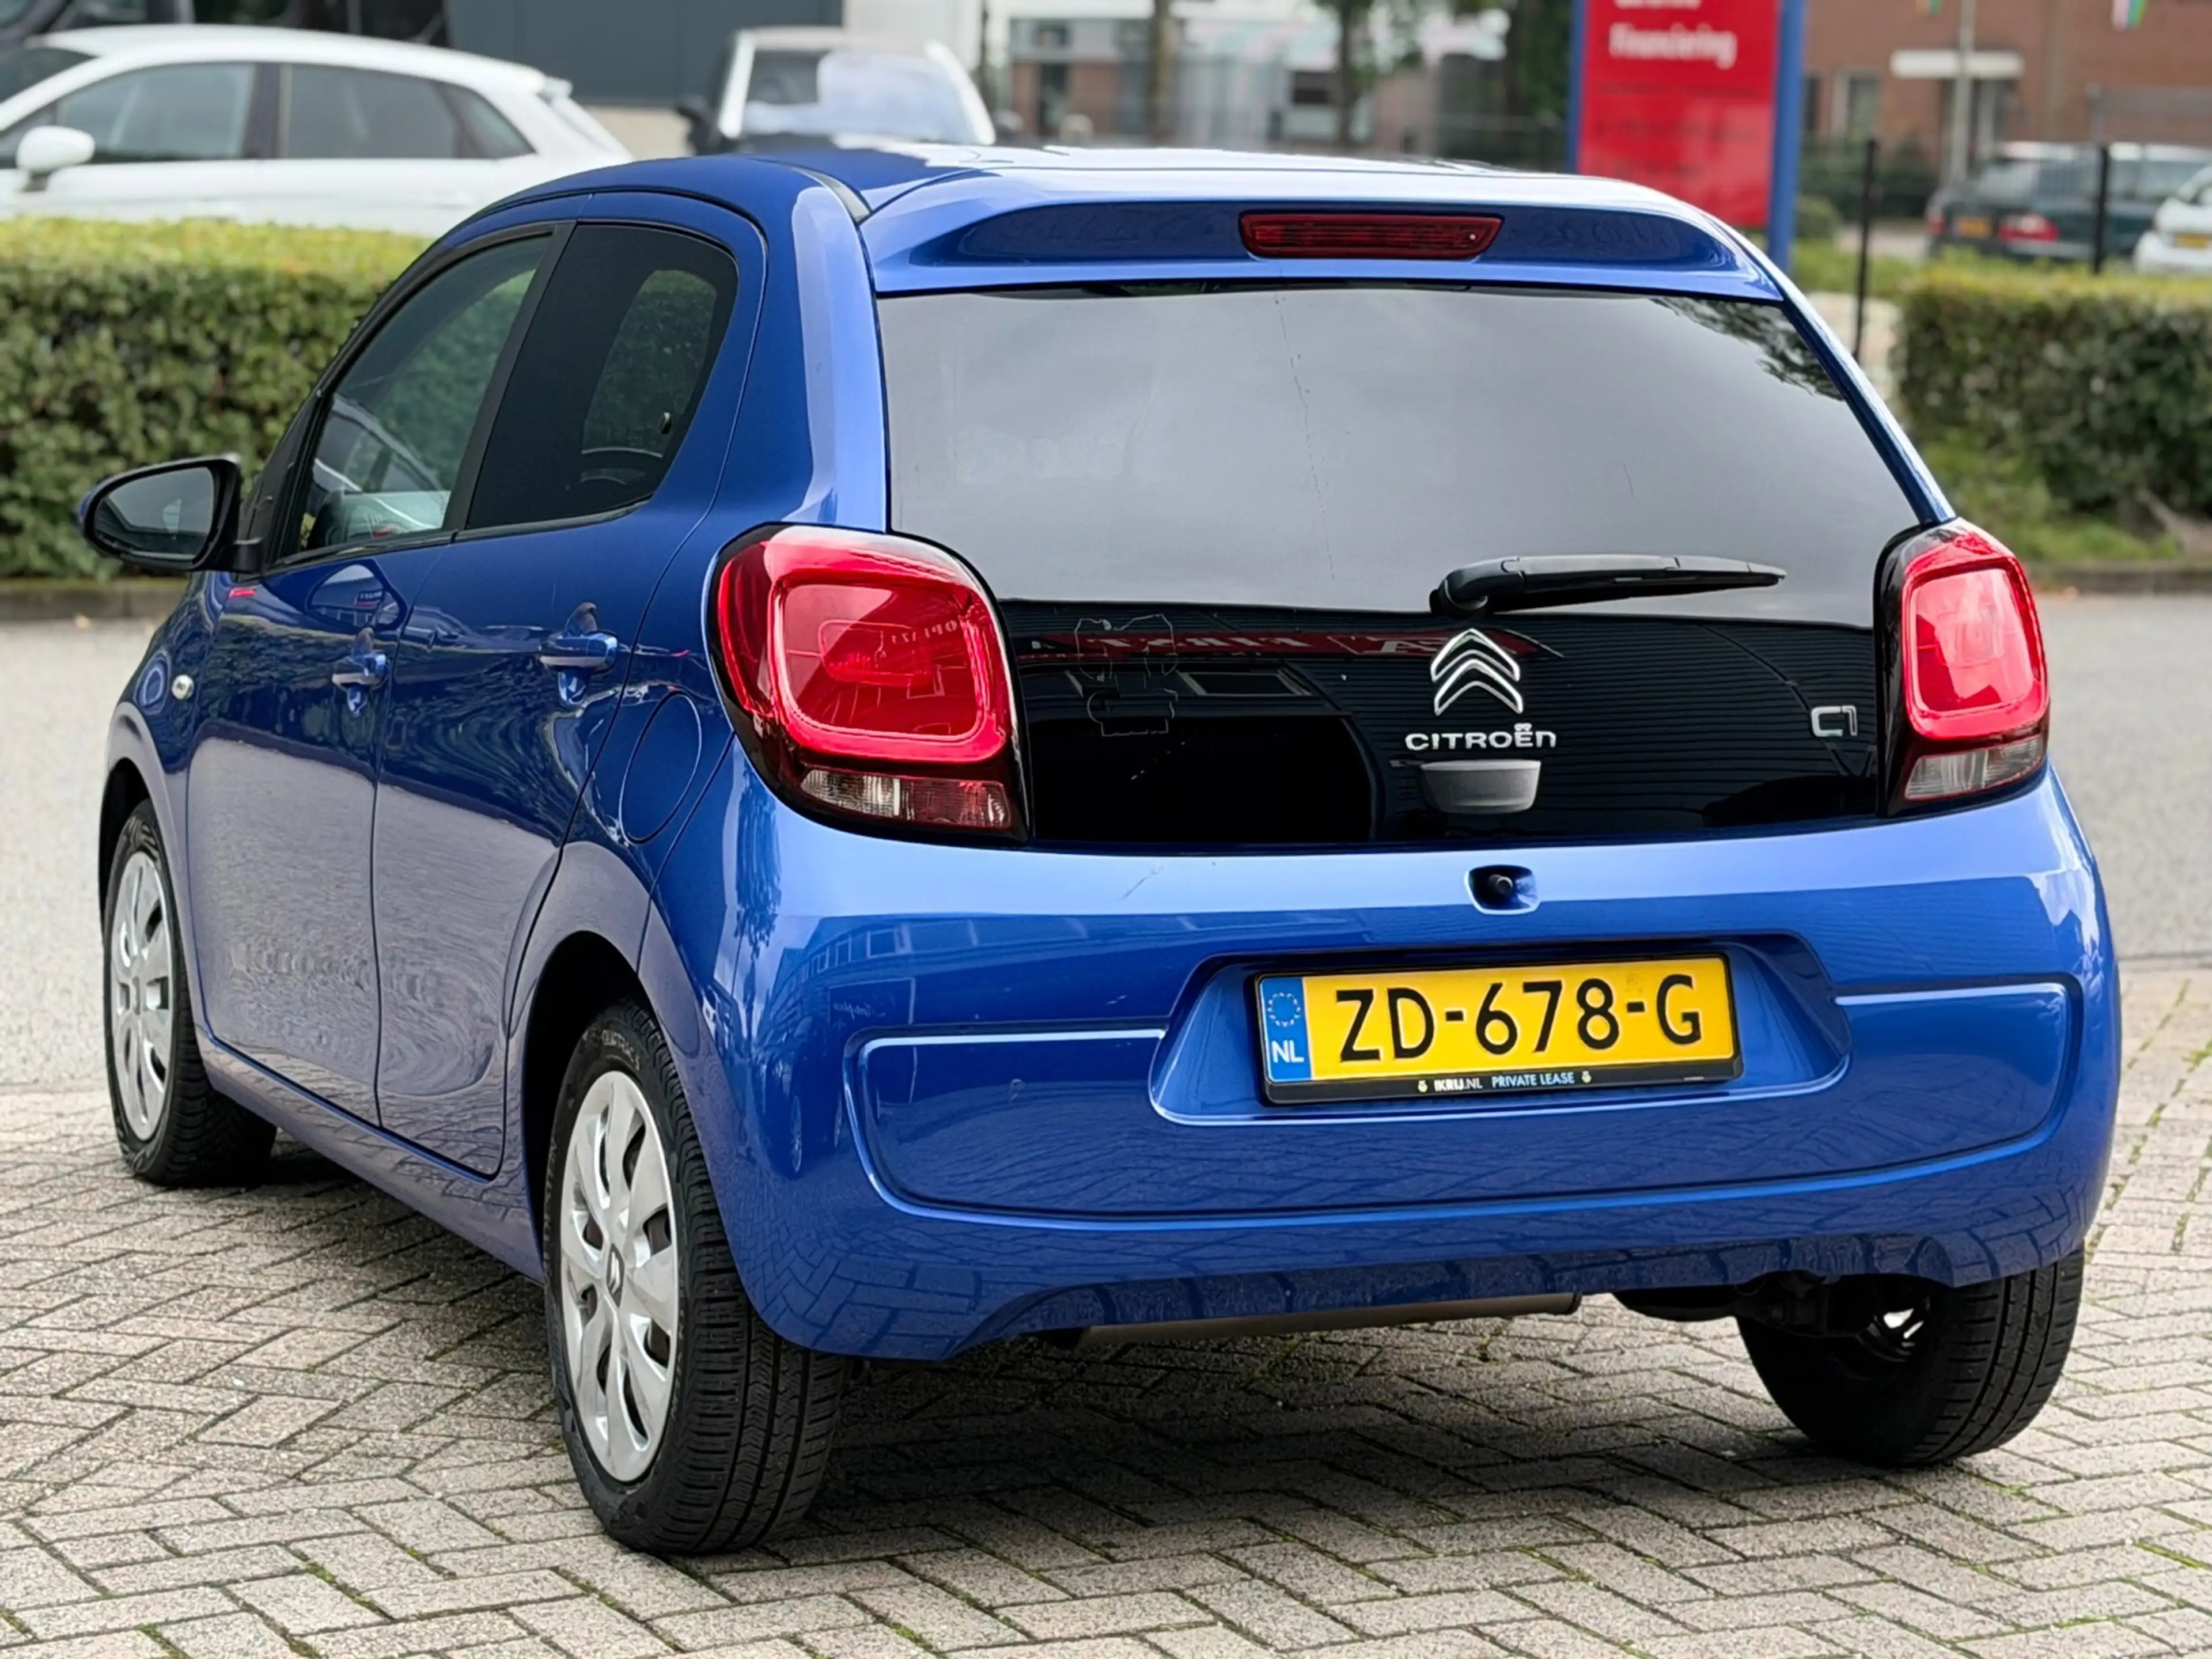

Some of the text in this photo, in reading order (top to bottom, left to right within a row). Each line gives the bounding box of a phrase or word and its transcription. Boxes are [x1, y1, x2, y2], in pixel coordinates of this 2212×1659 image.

[1811, 704, 1858, 737] C1
[1336, 974, 1702, 1063] ZD-678-G
[1271, 1039, 1305, 1063] NL
[1434, 1071, 1575, 1092] IKRIJ.NL PRIVATE LEASE
